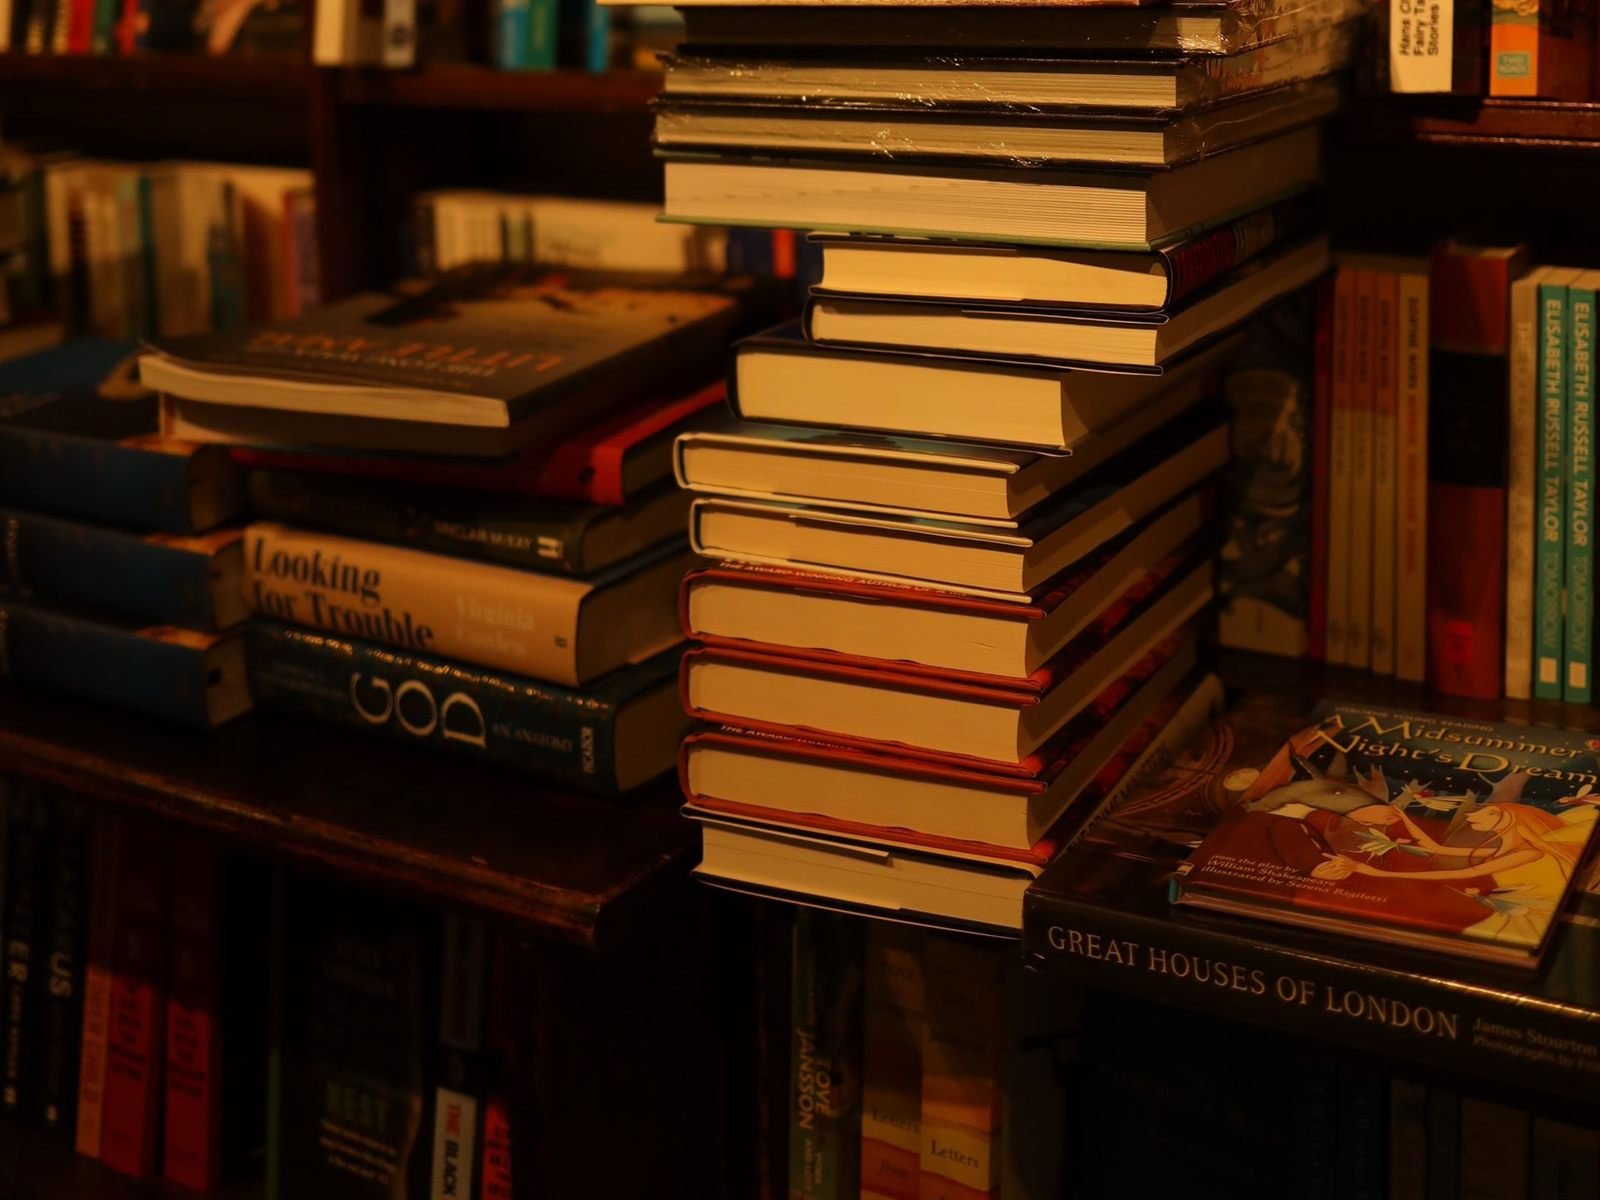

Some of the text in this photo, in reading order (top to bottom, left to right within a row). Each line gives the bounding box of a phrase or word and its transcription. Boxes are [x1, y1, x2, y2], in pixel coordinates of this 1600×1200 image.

[1399, 18, 1412, 56] Hans
[1413, 19, 1429, 56] Fairy
[1426, 3, 1440, 56] Stories
[1539, 297, 1562, 648] ELISABETH RUSSELL TAYLOR TOMORROW
[1567, 301, 1592, 653] ELISABETH RUSSELL TAYLOR TOMORROW
[253, 538, 383, 601] Looking
[303, 589, 434, 650] Trouble
[350, 671, 488, 750] GOD
[1348, 715, 1586, 760] Midsummer
[1301, 729, 1600, 786] Night's Dream
[1200, 865, 1265, 882] illustrated
[1267, 875, 1285, 887] by
[1285, 878, 1330, 893] Serena
[1207, 859, 1337, 887] William Shakespeare
[1238, 856, 1256, 867] the
[1256, 859, 1283, 871] play
[1284, 862, 1300, 874] by
[1047, 924, 1461, 1041] GREAT HOUSES OF LONDON
[1471, 1033, 1577, 1072] Photographs by
[1472, 1016, 1600, 1059] James Stourton
[796, 1026, 815, 1131] JANSSON
[814, 1056, 833, 1118] TOVE
[443, 1103, 462, 1197] THE BLACK
[929, 1139, 980, 1169] Letters
